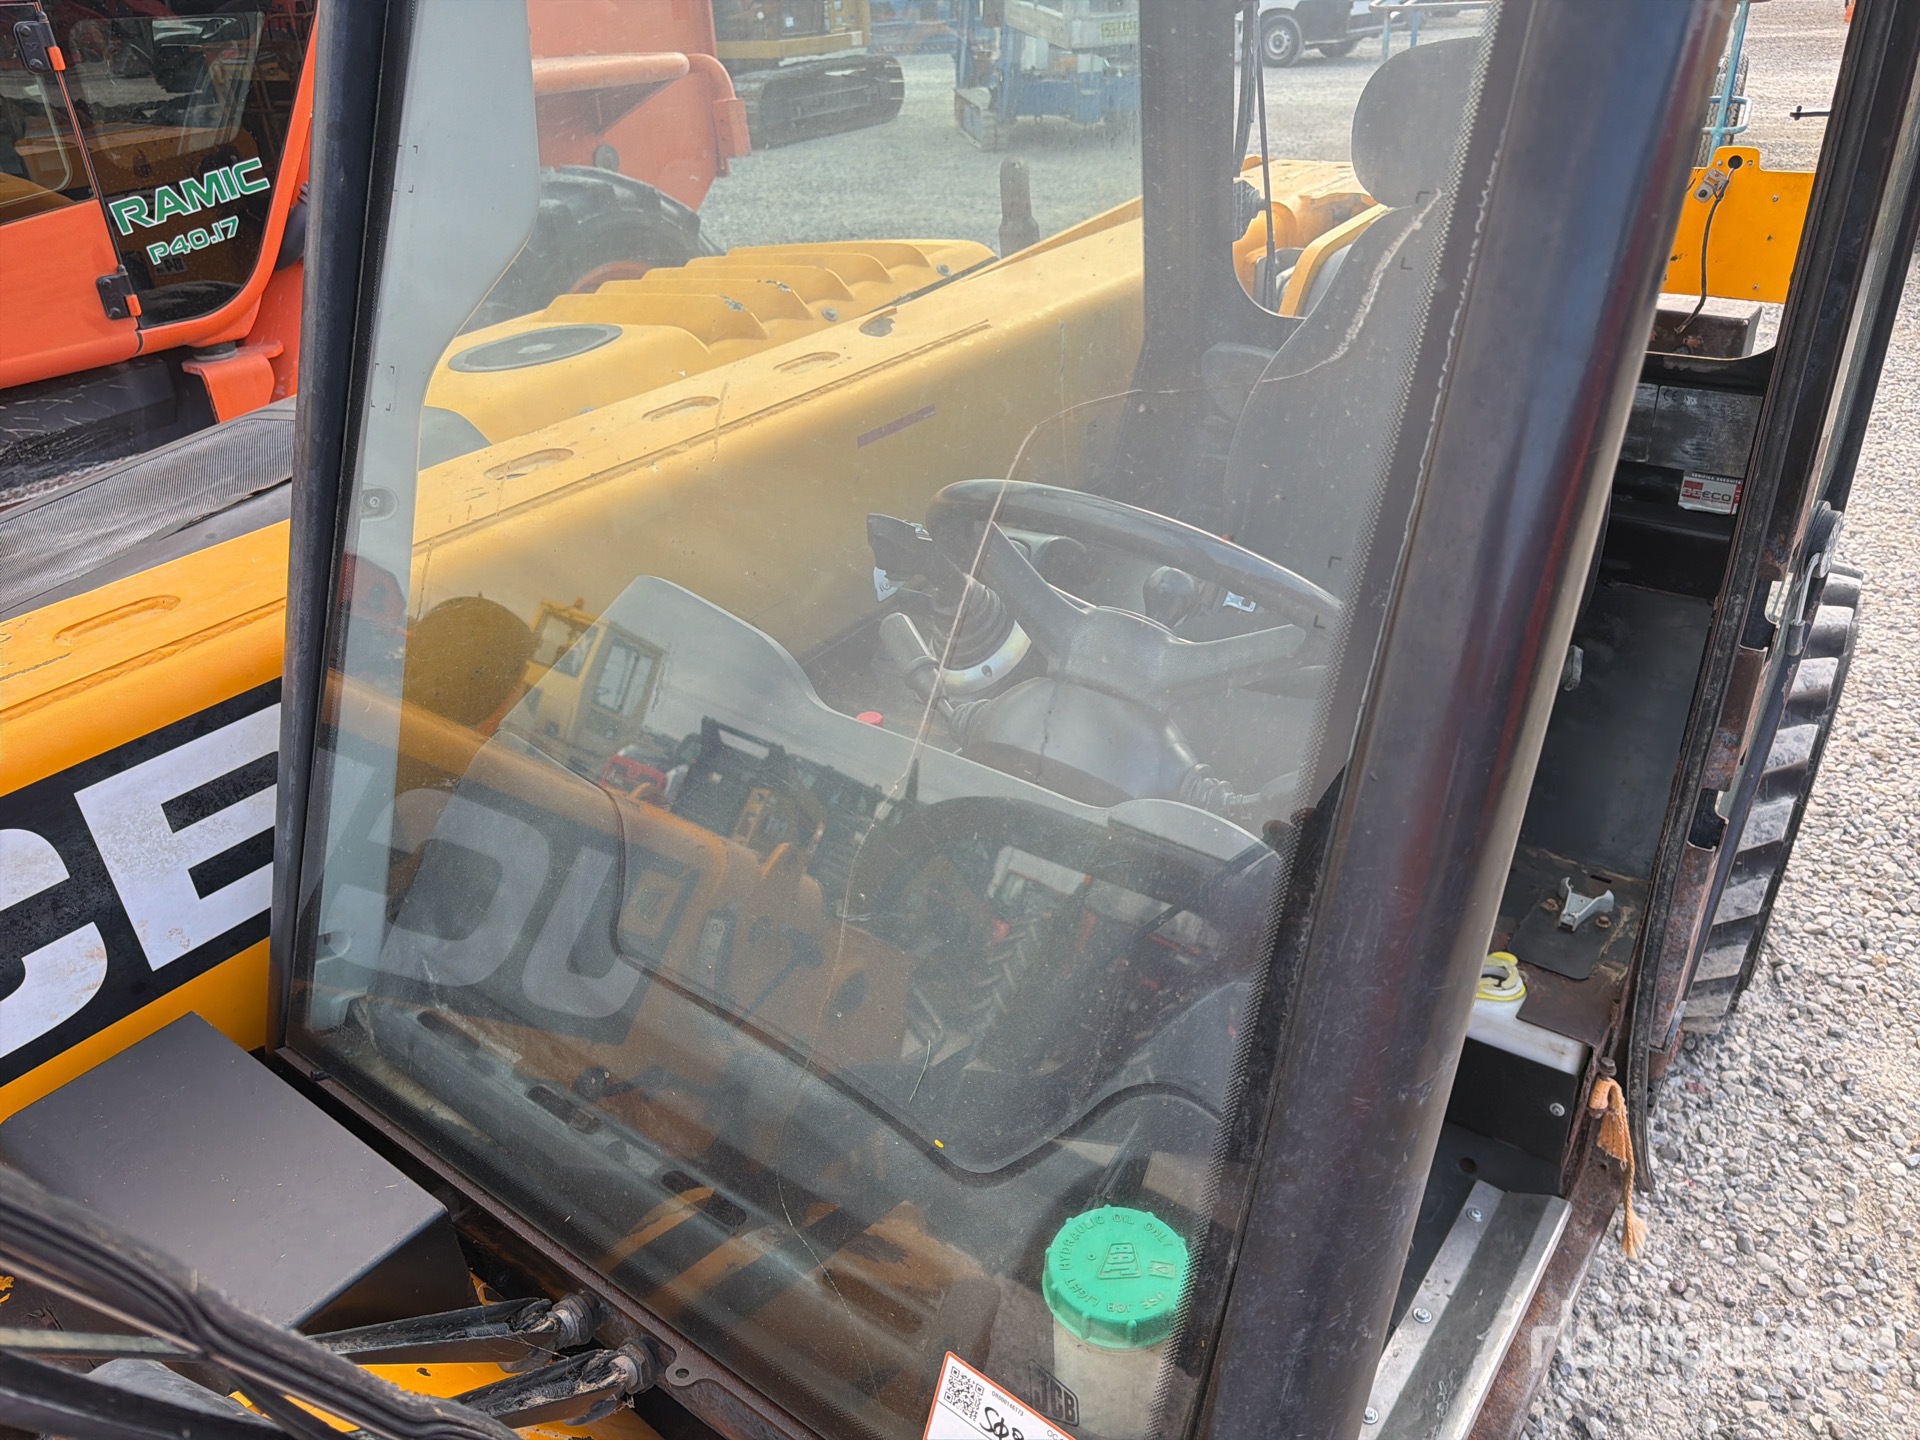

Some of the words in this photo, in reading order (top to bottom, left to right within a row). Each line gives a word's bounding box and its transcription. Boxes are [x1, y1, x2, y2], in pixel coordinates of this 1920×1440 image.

[108, 157, 271, 236] RAMIC
[146, 215, 239, 265] P40.17
[1059, 1215, 1105, 1271] HYDRAULIC
[1112, 1214, 1135, 1225] OIL
[1144, 1223, 1174, 1247] ONLY
